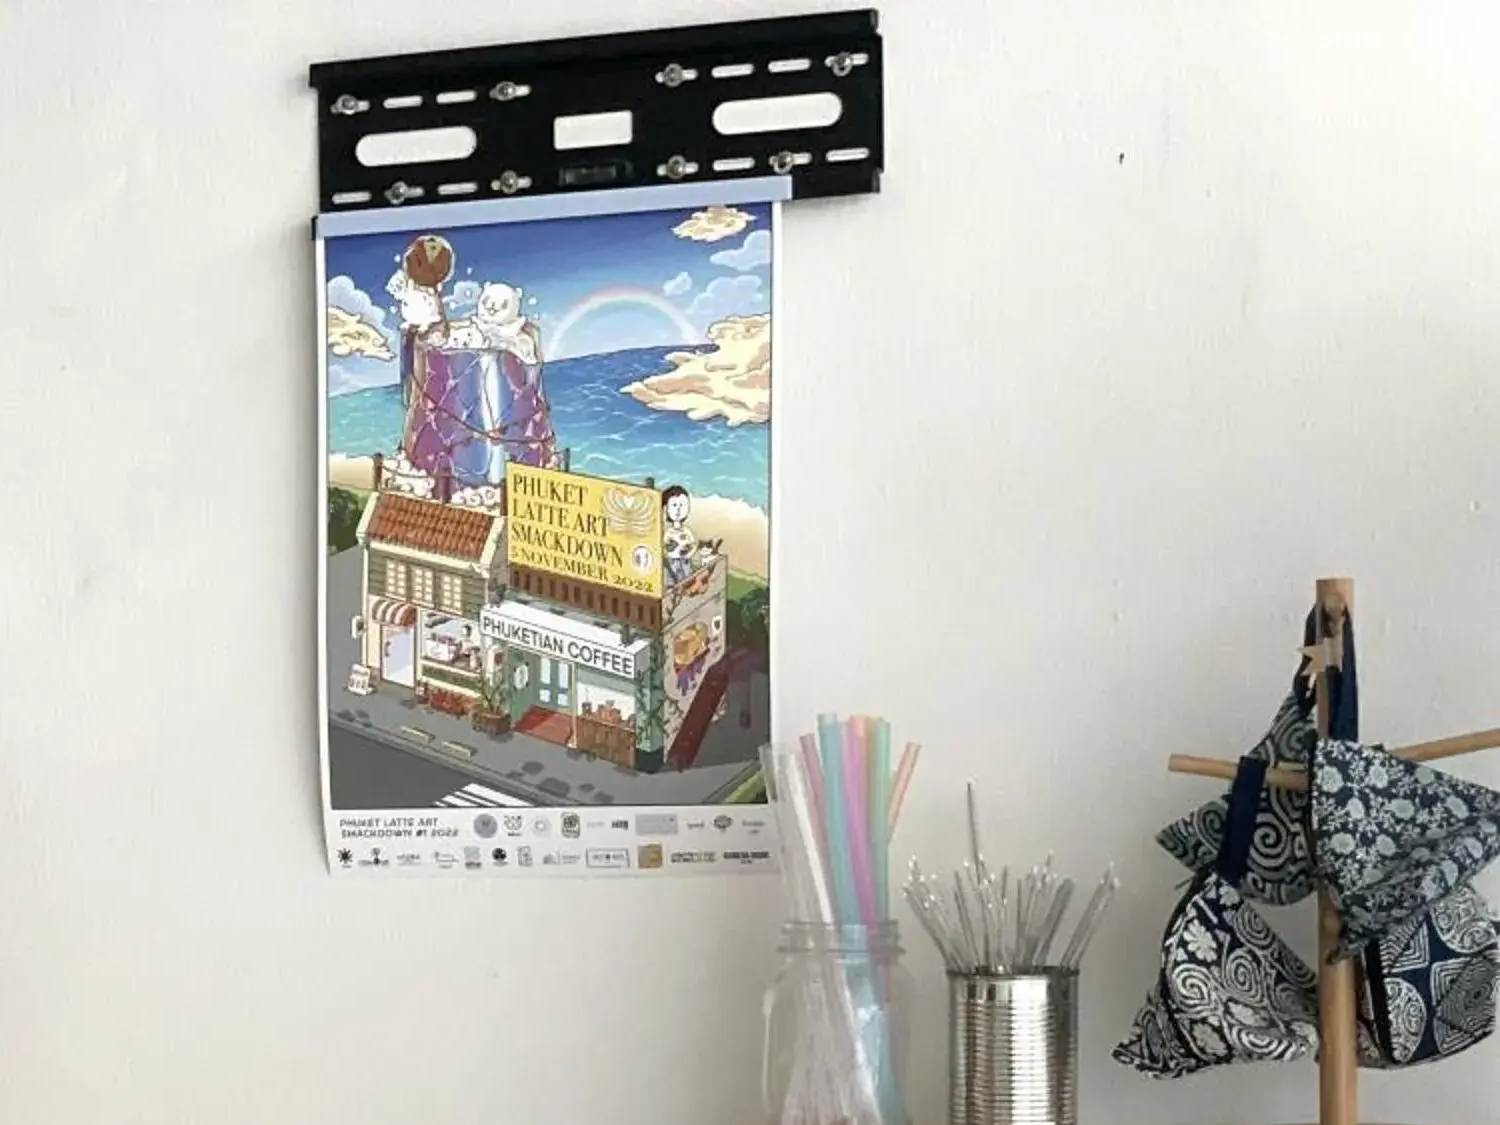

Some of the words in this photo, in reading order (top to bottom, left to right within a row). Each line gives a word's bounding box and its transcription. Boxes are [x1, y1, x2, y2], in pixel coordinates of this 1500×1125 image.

[512, 472, 589, 507] PHUKET
[512, 499, 571, 528] LATTE
[574, 511, 610, 537] ART
[511, 522, 624, 569] SMACKDOWN
[520, 548, 609, 582] NOVEMBER
[613, 574, 654, 593] 2022
[483, 615, 564, 654] PHUKETIAN
[568, 641, 633, 675] COFFEE
[339, 819, 380, 828] PHUKET
[383, 818, 415, 828] LATTE
[418, 818, 439, 827] ART
[341, 829, 412, 839] SMACKDOWN
